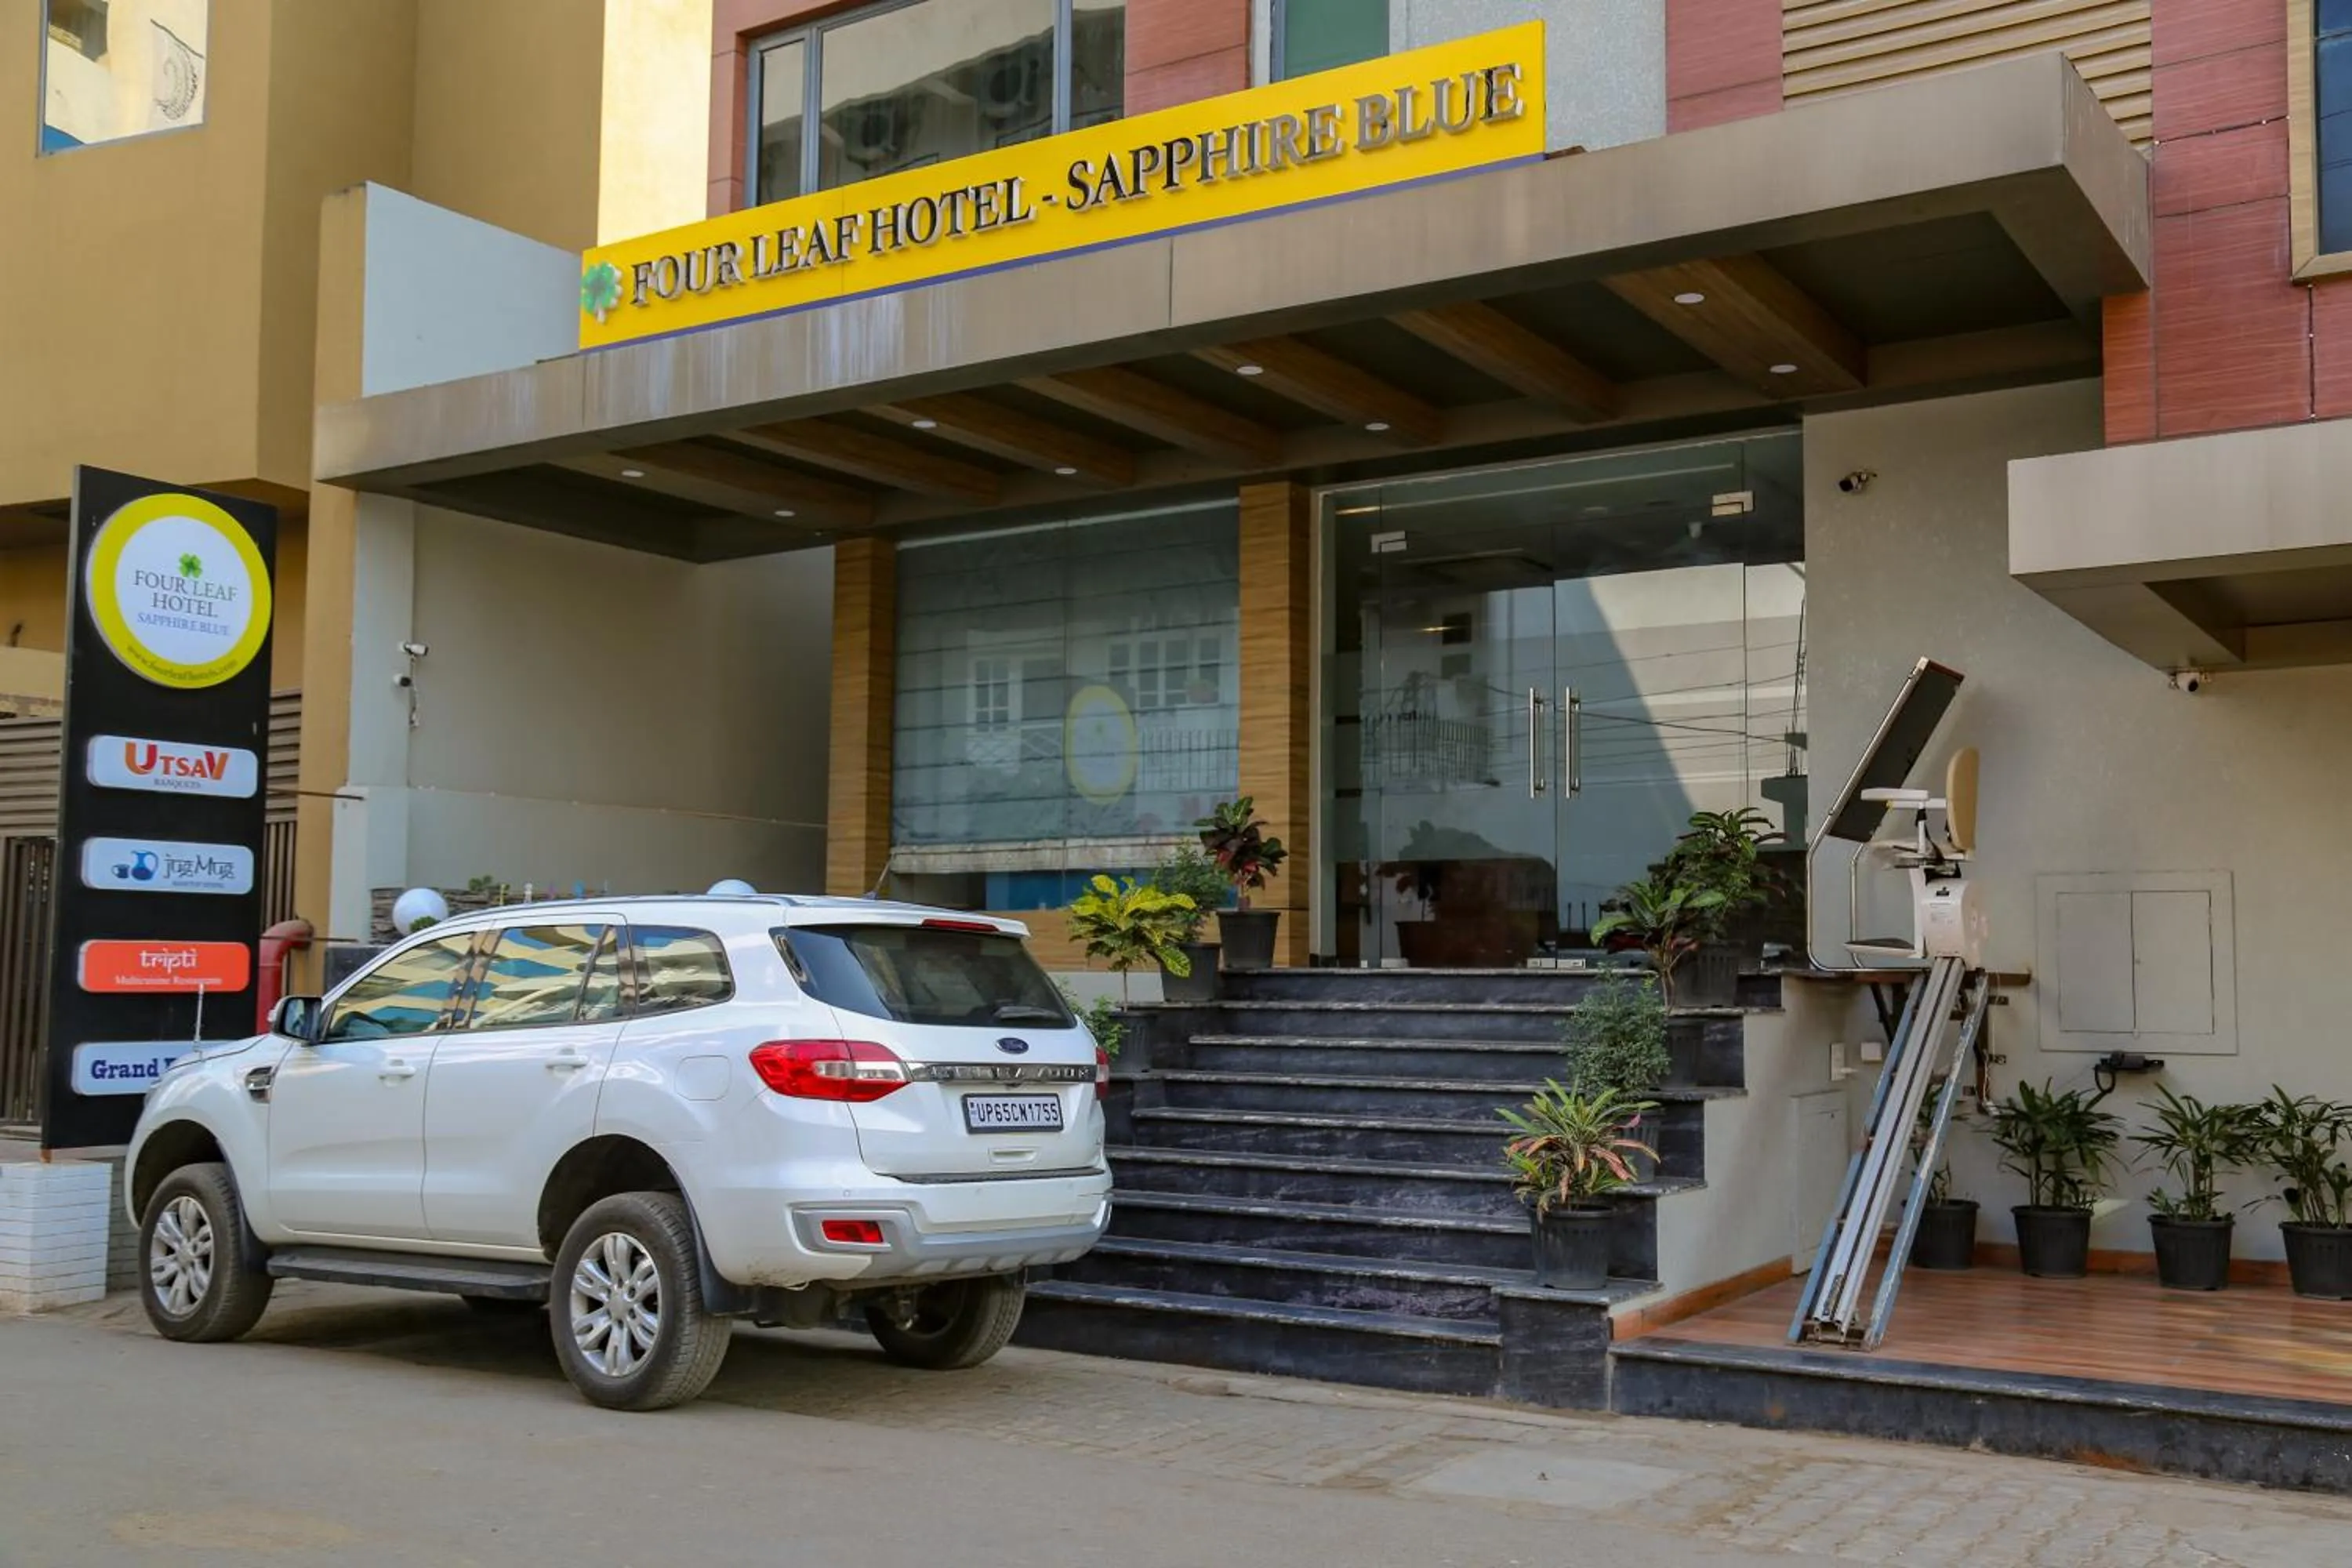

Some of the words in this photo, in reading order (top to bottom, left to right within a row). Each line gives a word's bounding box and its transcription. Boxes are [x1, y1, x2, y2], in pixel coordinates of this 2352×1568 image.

[630, 241, 744, 307] FOUR
[750, 213, 864, 278] LEAF
[868, 176, 1036, 256] HOTEL
[1067, 103, 1342, 212] SAPPHIRE
[1353, 63, 1524, 152] BLUE
[133, 569, 187, 594] FOUR
[191, 580, 238, 601] LEAF
[151, 592, 218, 618] HOTEL
[137, 612, 198, 631] SAPPHIRE
[140, 947, 198, 974] tripti
[91, 1058, 159, 1079] Grand
[976, 1102, 1058, 1122] UP65CN1755
